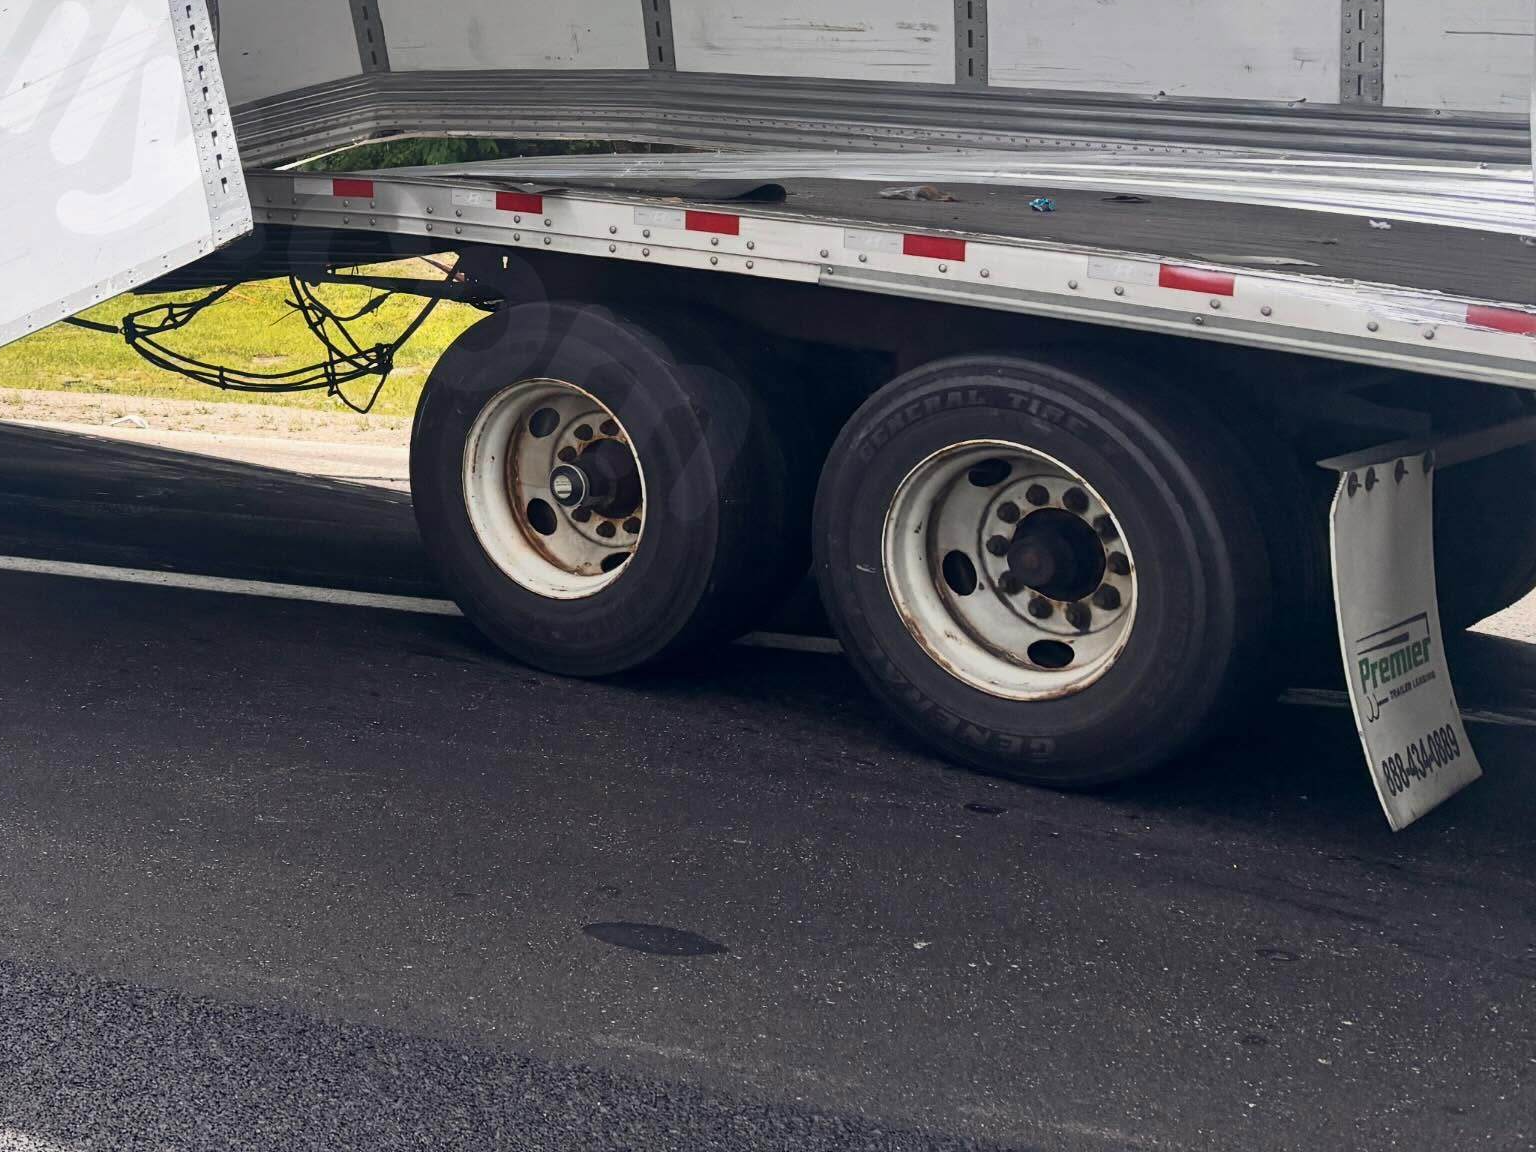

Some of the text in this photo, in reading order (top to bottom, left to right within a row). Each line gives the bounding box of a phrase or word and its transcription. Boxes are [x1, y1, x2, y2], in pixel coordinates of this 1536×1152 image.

[858, 389, 1089, 462] GENERAL TIRE
[1358, 636, 1431, 694] Premier
[1381, 723, 1461, 797] 888-434-0889
